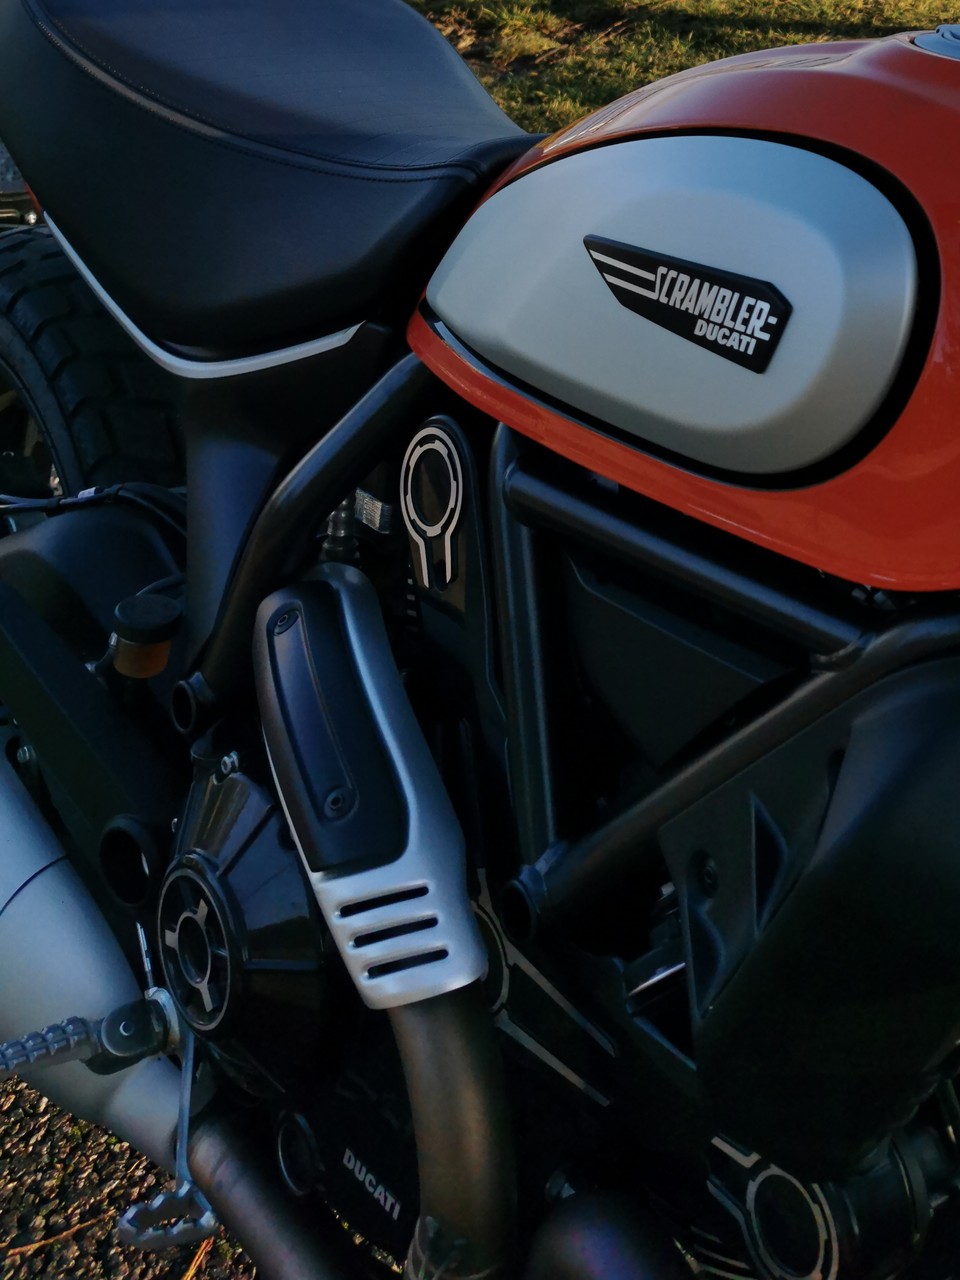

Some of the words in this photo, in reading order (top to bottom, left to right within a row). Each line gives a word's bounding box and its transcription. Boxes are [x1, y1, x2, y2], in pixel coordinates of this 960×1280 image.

[654, 265, 777, 341] SCRAMBLER
[694, 319, 757, 355] DUCATI
[342, 1148, 401, 1221] DUCATI
